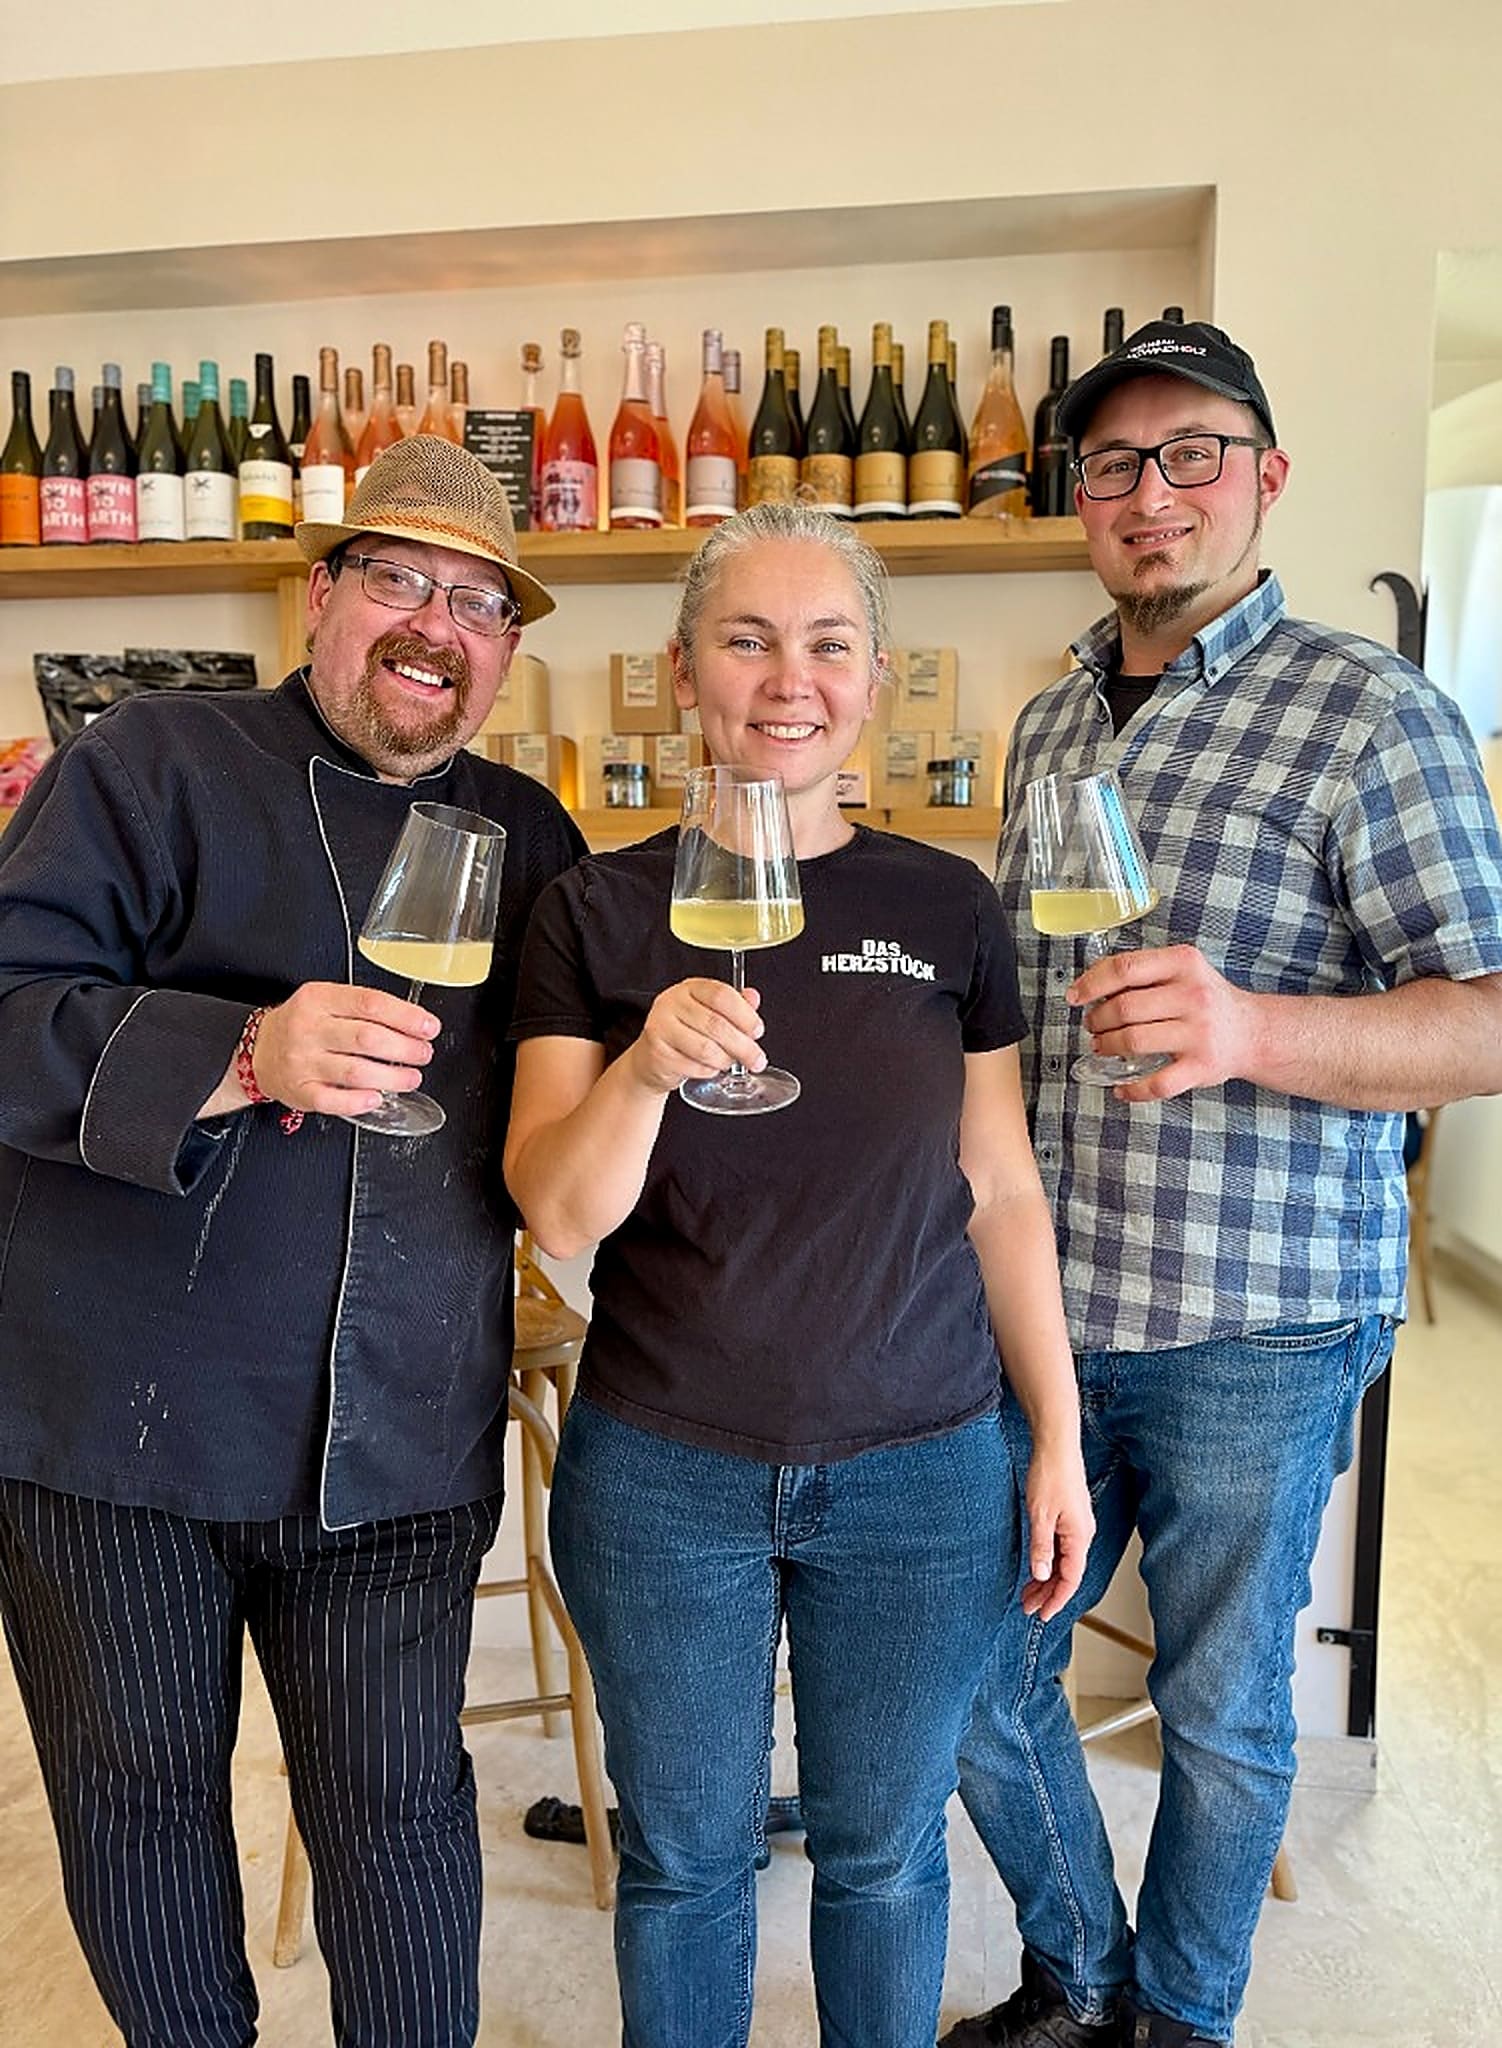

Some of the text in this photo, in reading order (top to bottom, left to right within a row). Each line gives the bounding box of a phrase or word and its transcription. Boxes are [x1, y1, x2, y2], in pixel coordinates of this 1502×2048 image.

[41, 483, 83, 498] OWN
[42, 512, 84, 528] ARTH
[89, 510, 132, 526] ARTH
[862, 939, 901, 958] DAS
[821, 953, 936, 981] HERZSTÜCK
